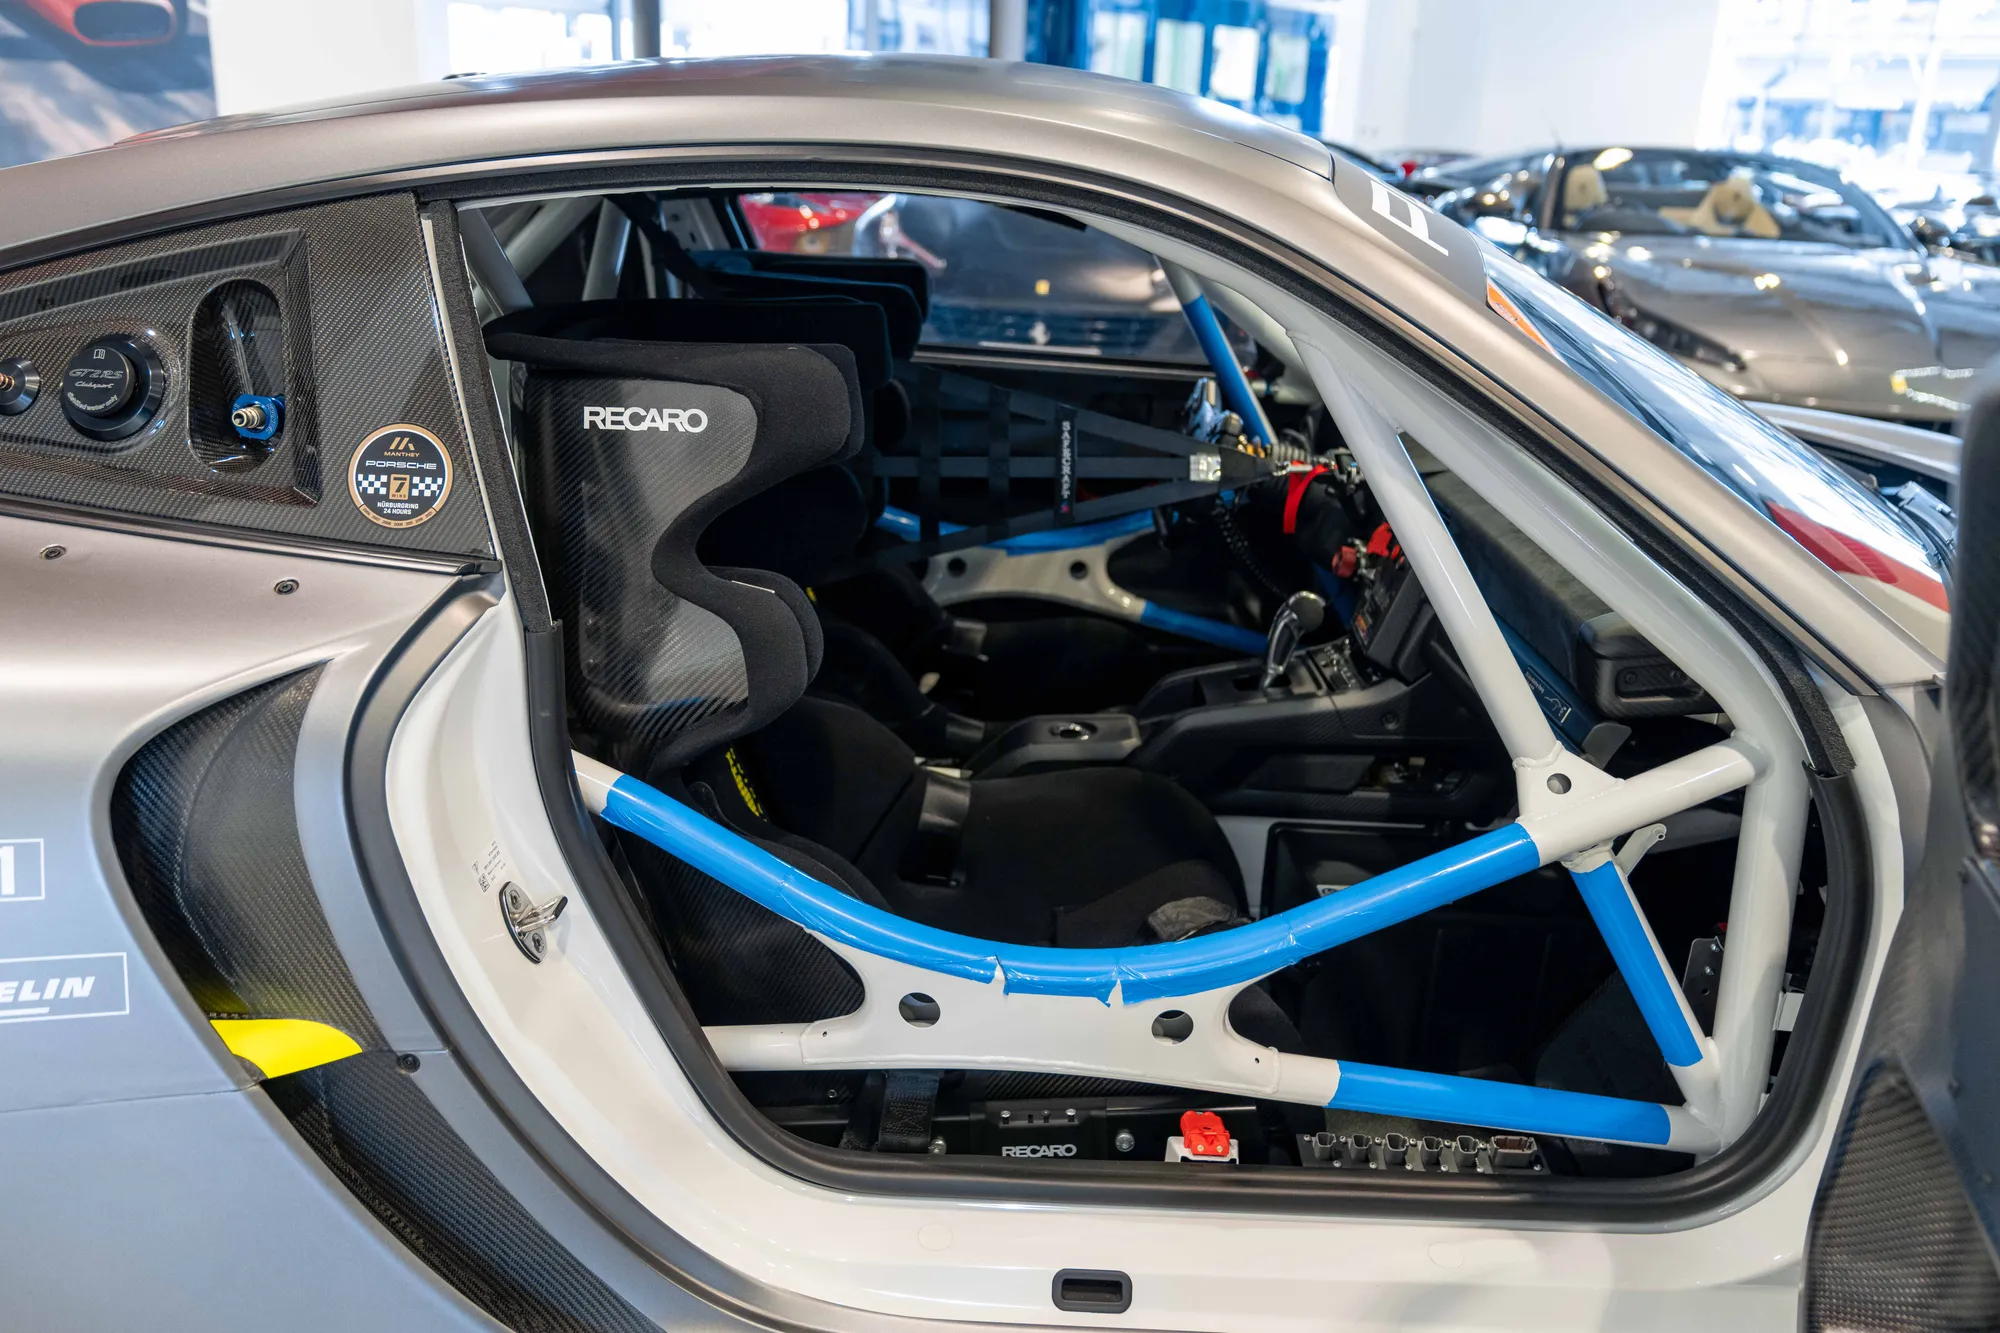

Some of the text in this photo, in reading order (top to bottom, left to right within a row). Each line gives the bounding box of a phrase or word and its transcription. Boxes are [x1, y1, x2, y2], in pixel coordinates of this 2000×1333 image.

[583, 406, 708, 433] RECARO
[366, 460, 437, 470] PORSCHE
[393, 476, 407, 493] 7
[377, 501, 419, 510] NÜRBURGRING
[1002, 1144, 1077, 1158] RECARO
